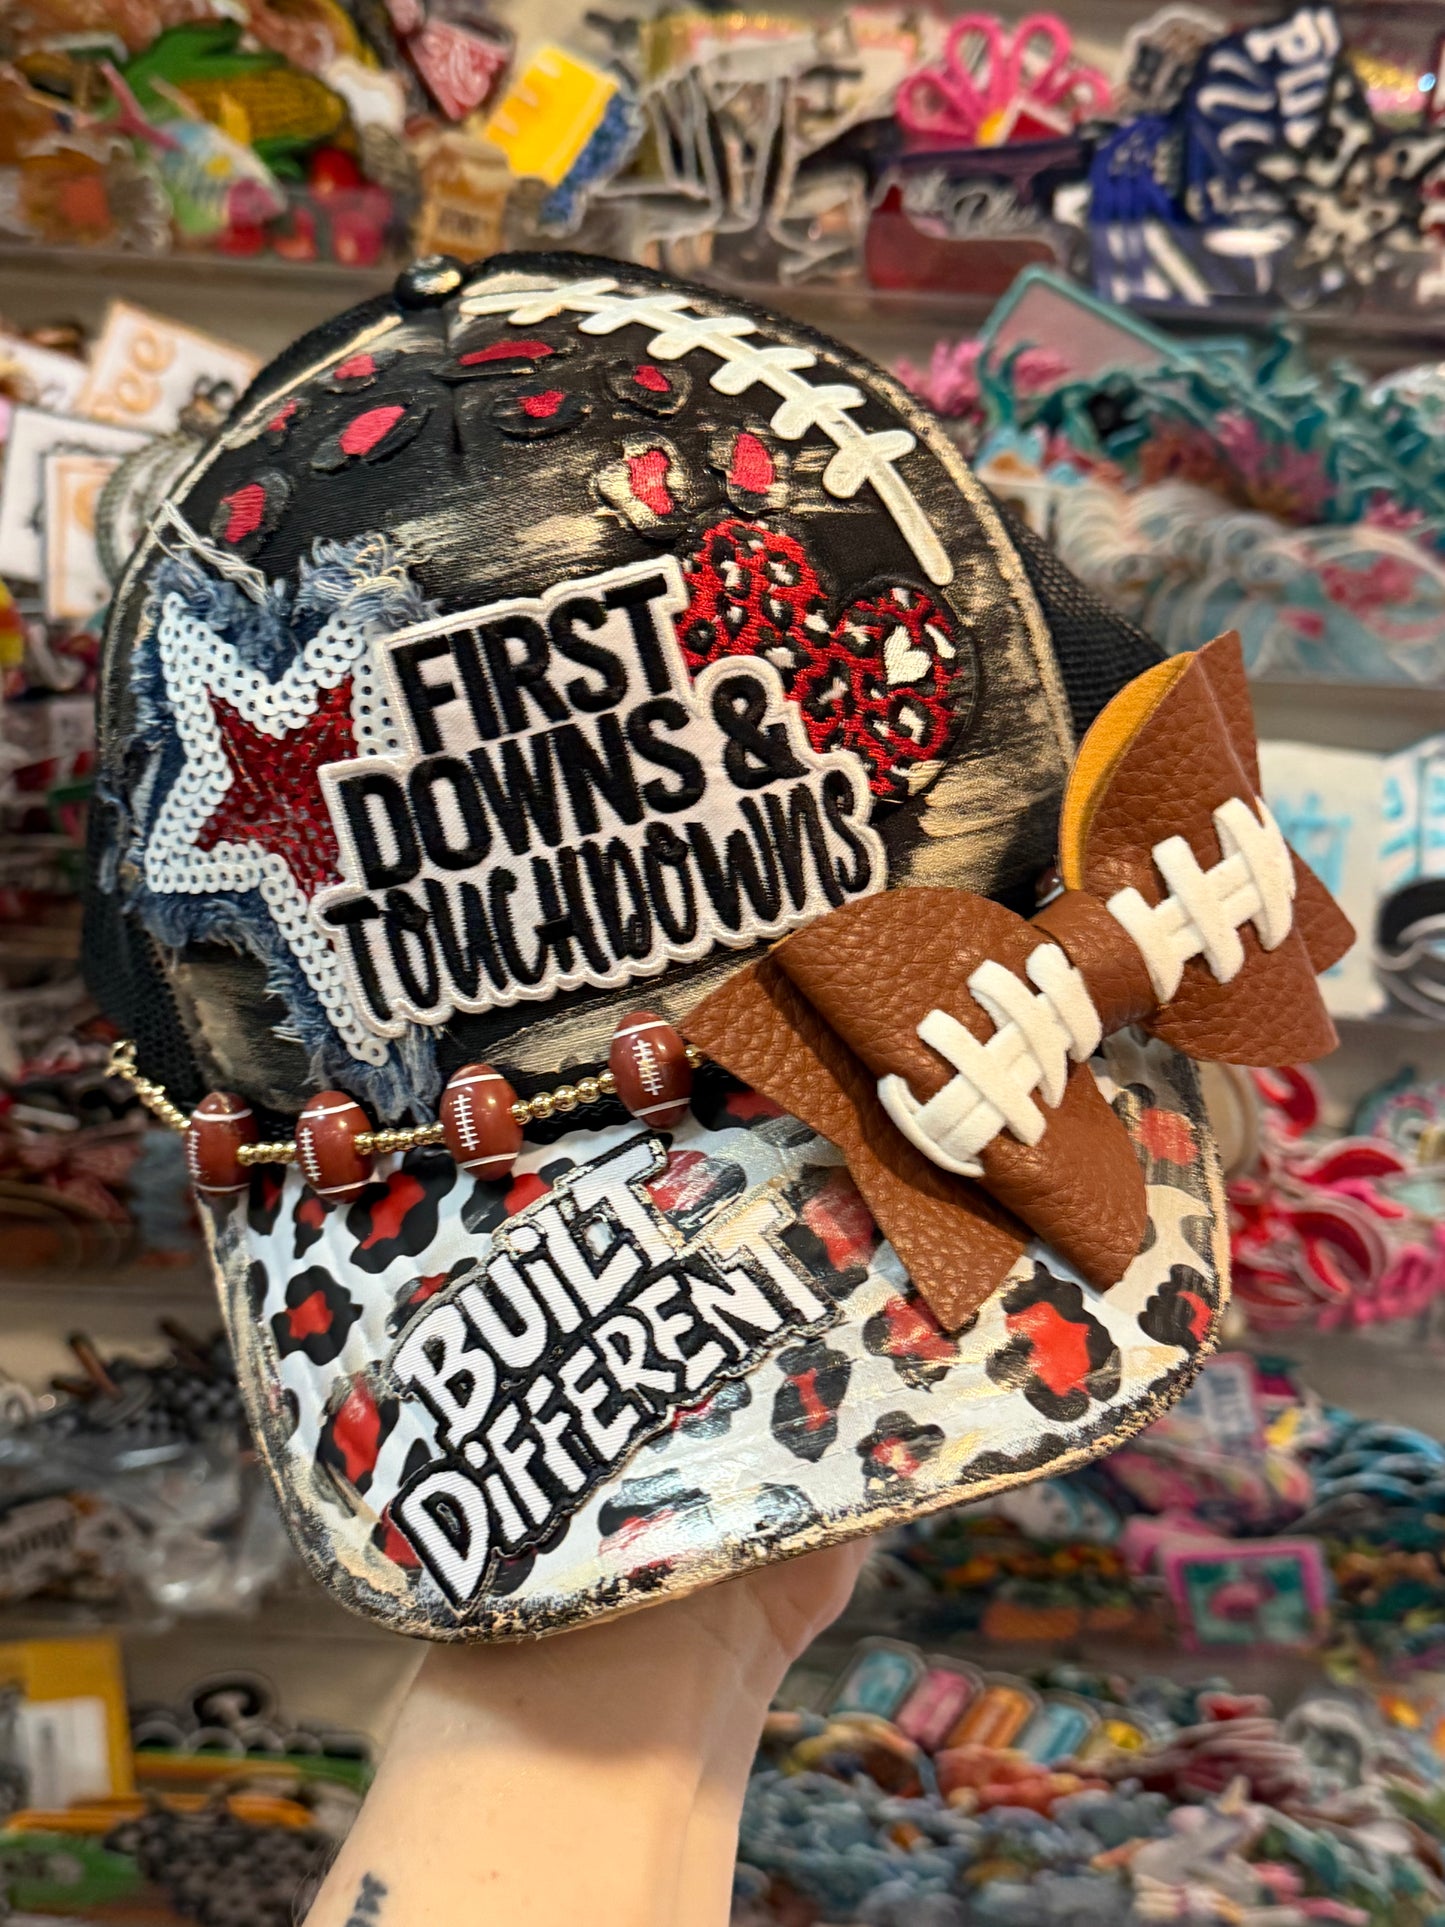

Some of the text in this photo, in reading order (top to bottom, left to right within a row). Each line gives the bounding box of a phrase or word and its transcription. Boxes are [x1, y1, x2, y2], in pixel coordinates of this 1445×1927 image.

[390, 574, 675, 755] FIRST
[340, 675, 810, 891] DOWNS &
[323, 770, 871, 1021] TOUCHDOWNS
